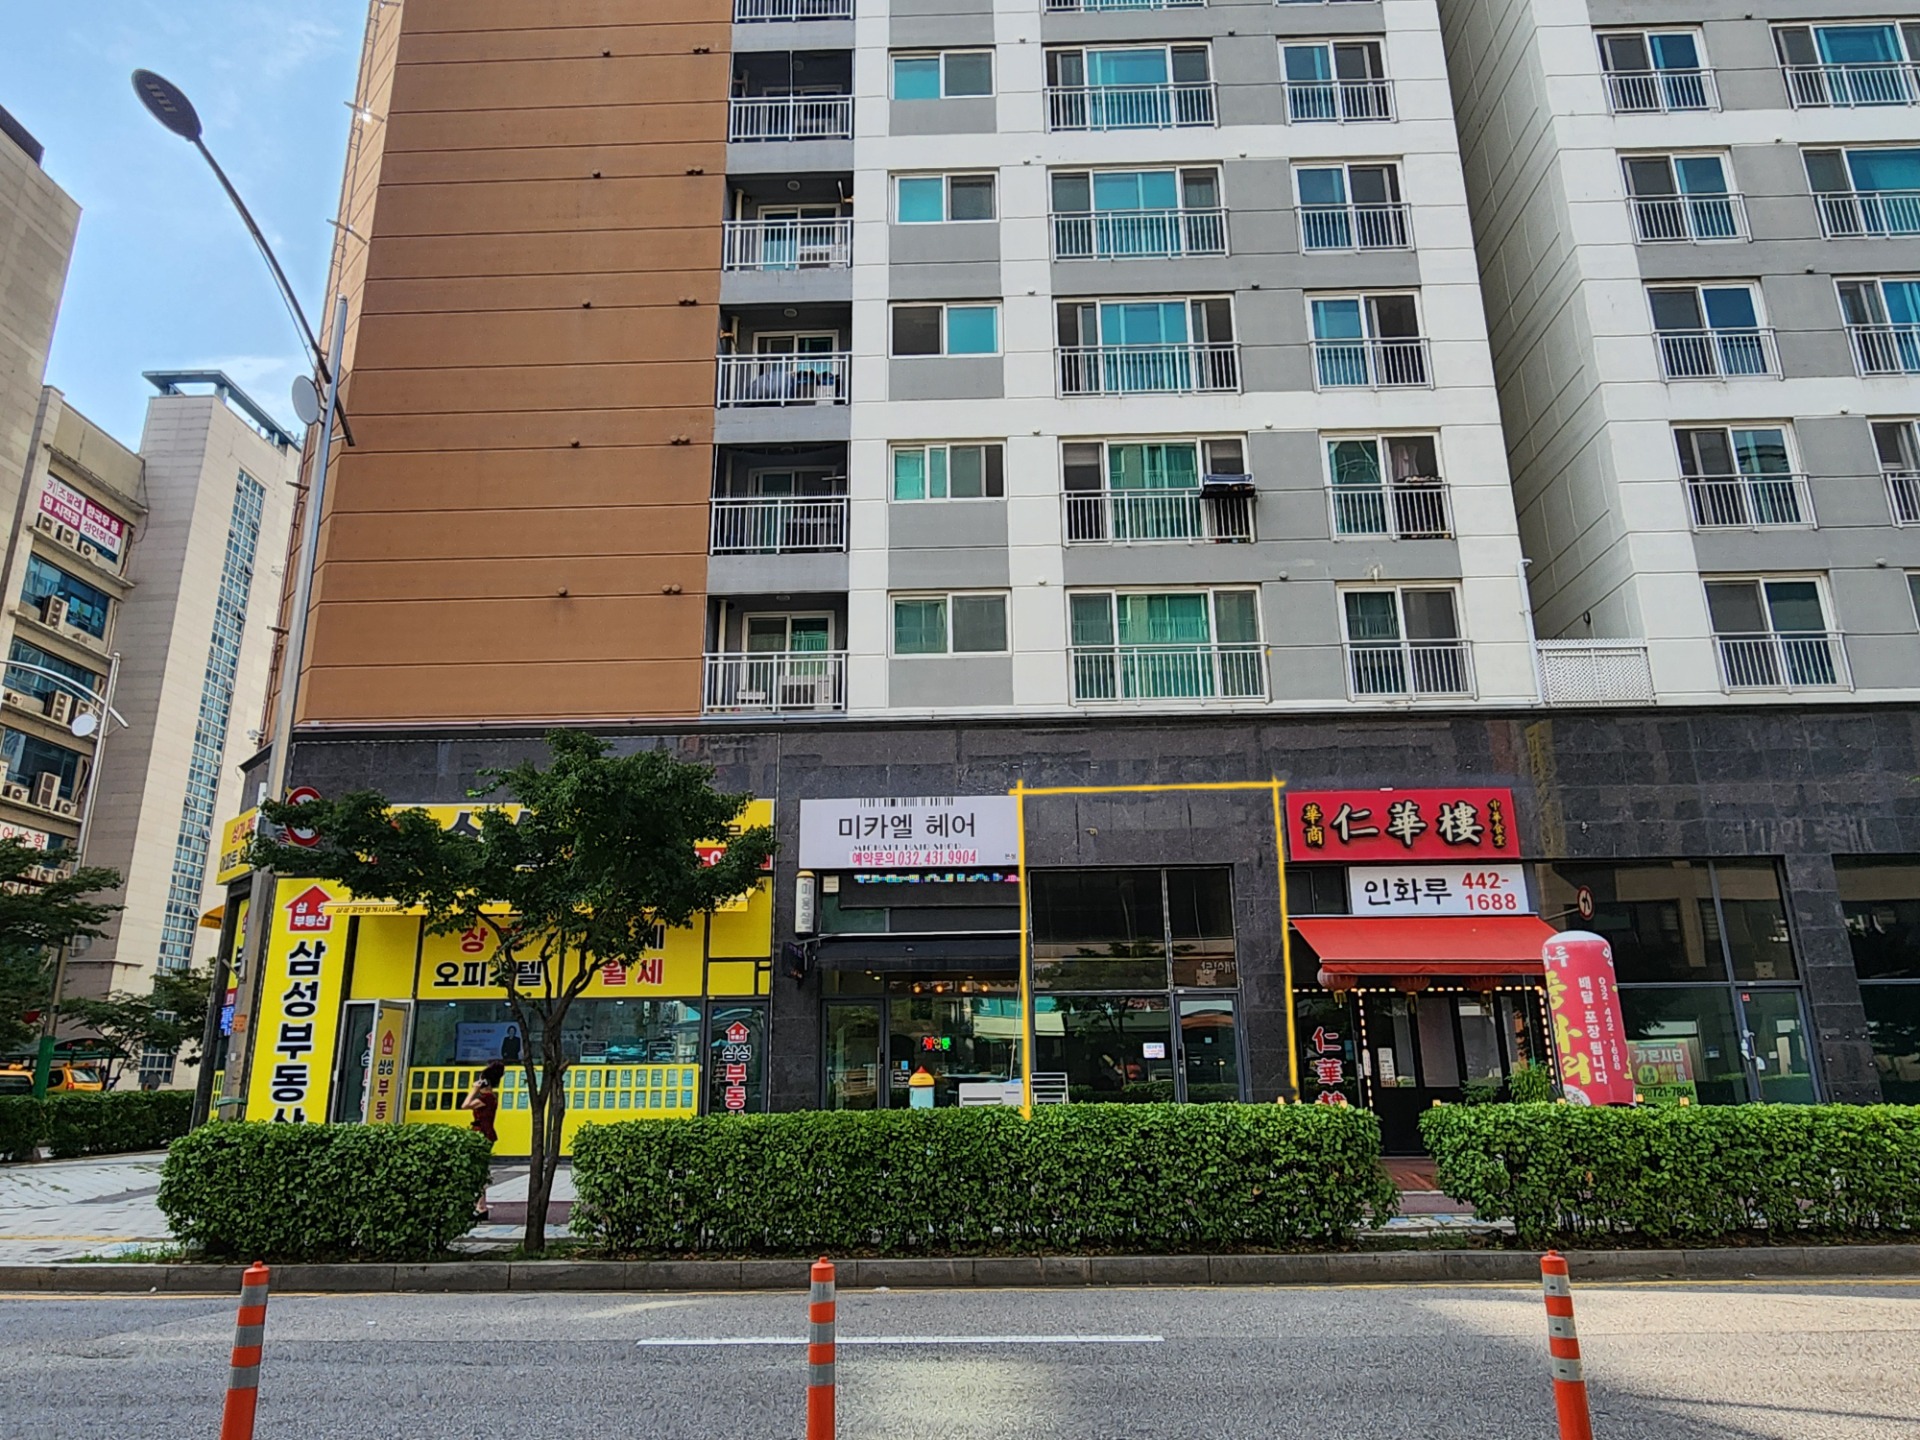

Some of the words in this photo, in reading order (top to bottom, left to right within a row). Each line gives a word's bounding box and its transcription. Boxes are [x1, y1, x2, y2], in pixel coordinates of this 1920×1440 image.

[838, 813, 913, 839] 미카엘
[926, 812, 975, 838] 헤어
[1333, 801, 1484, 846] 仁華樓
[898, 850, 977, 866] 032.431.9904
[1364, 878, 1452, 905] 인화루
[1461, 872, 1509, 890] 442-
[1465, 893, 1517, 911] 1688
[725, 1063, 747, 1115] 부동
